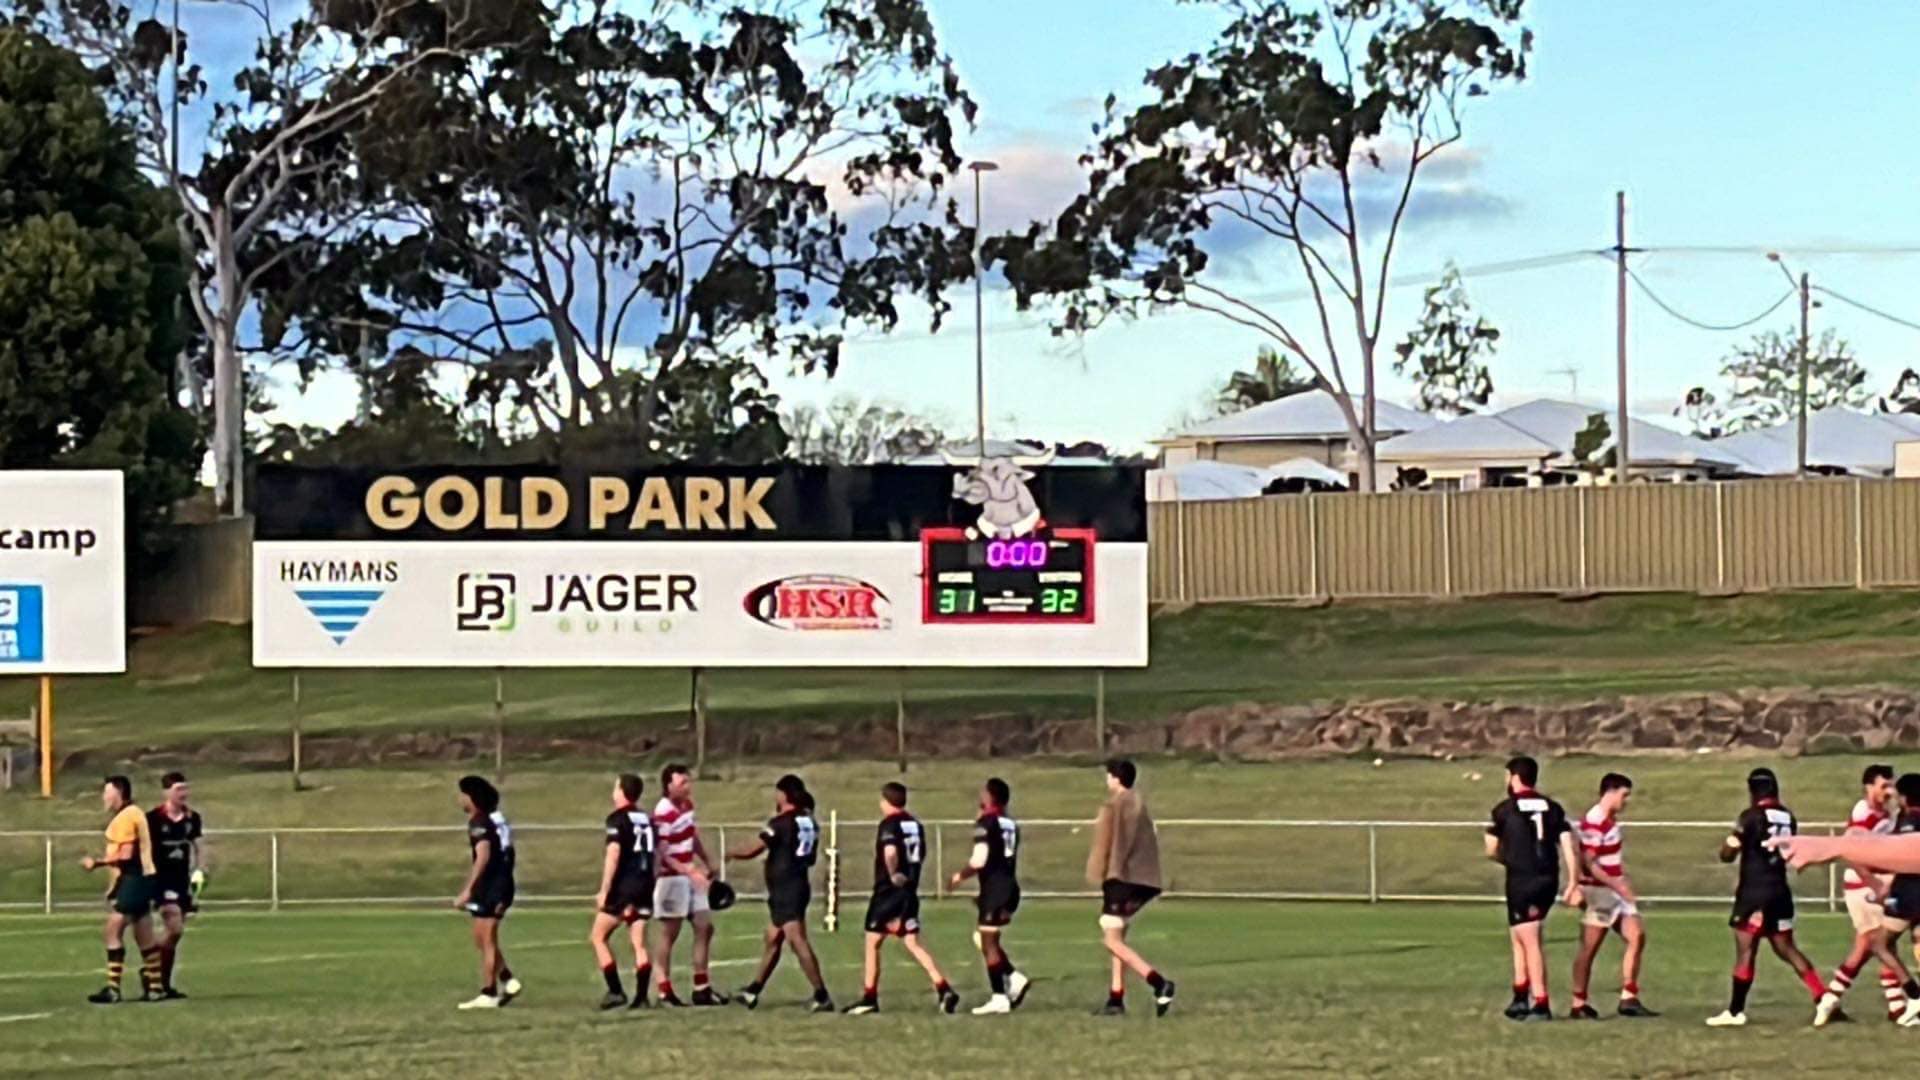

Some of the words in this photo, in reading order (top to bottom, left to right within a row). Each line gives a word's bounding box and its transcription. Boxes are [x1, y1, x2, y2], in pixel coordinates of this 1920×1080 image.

[365, 475, 569, 531] GOLD
[589, 476, 777, 530] PARK
[986, 541, 1047, 567] 0:00
[280, 560, 399, 583] HAYMANS
[777, 587, 879, 619] HSR
[939, 588, 976, 613] 31
[1041, 588, 1079, 613] 32
[557, 617, 673, 634] GUILD
[1530, 812, 1544, 840] 1
